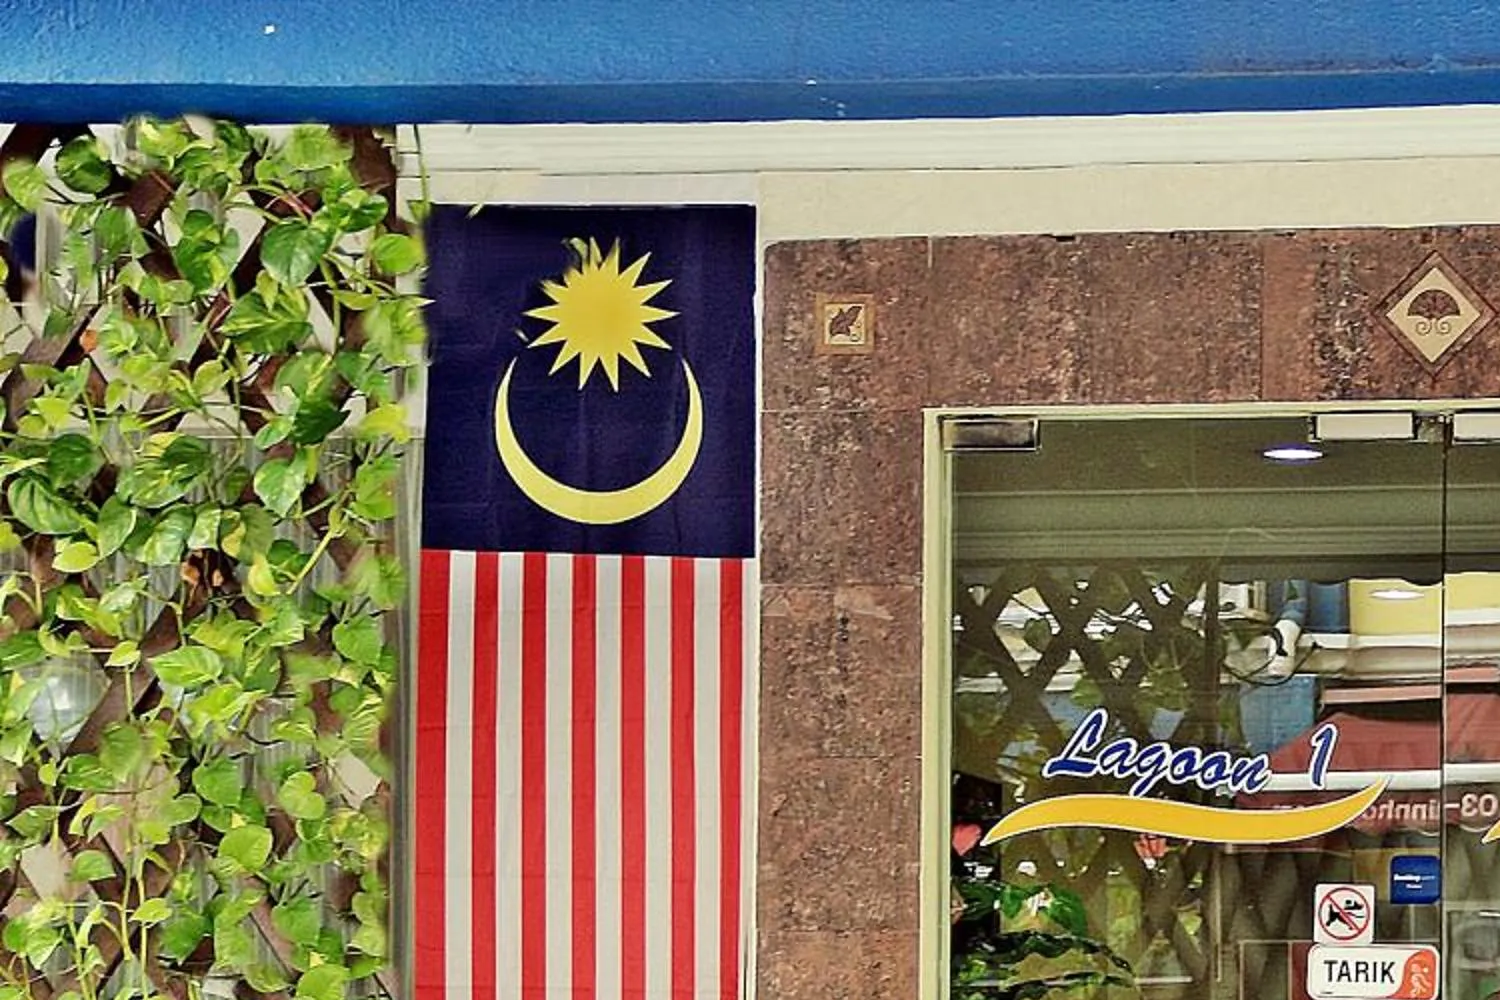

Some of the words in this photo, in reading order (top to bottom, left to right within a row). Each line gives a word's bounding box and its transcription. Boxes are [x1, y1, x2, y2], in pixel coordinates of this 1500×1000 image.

[1042, 707, 1272, 797] Lagoon
[1309, 723, 1340, 790] 1
[1323, 959, 1397, 984] TARIK
